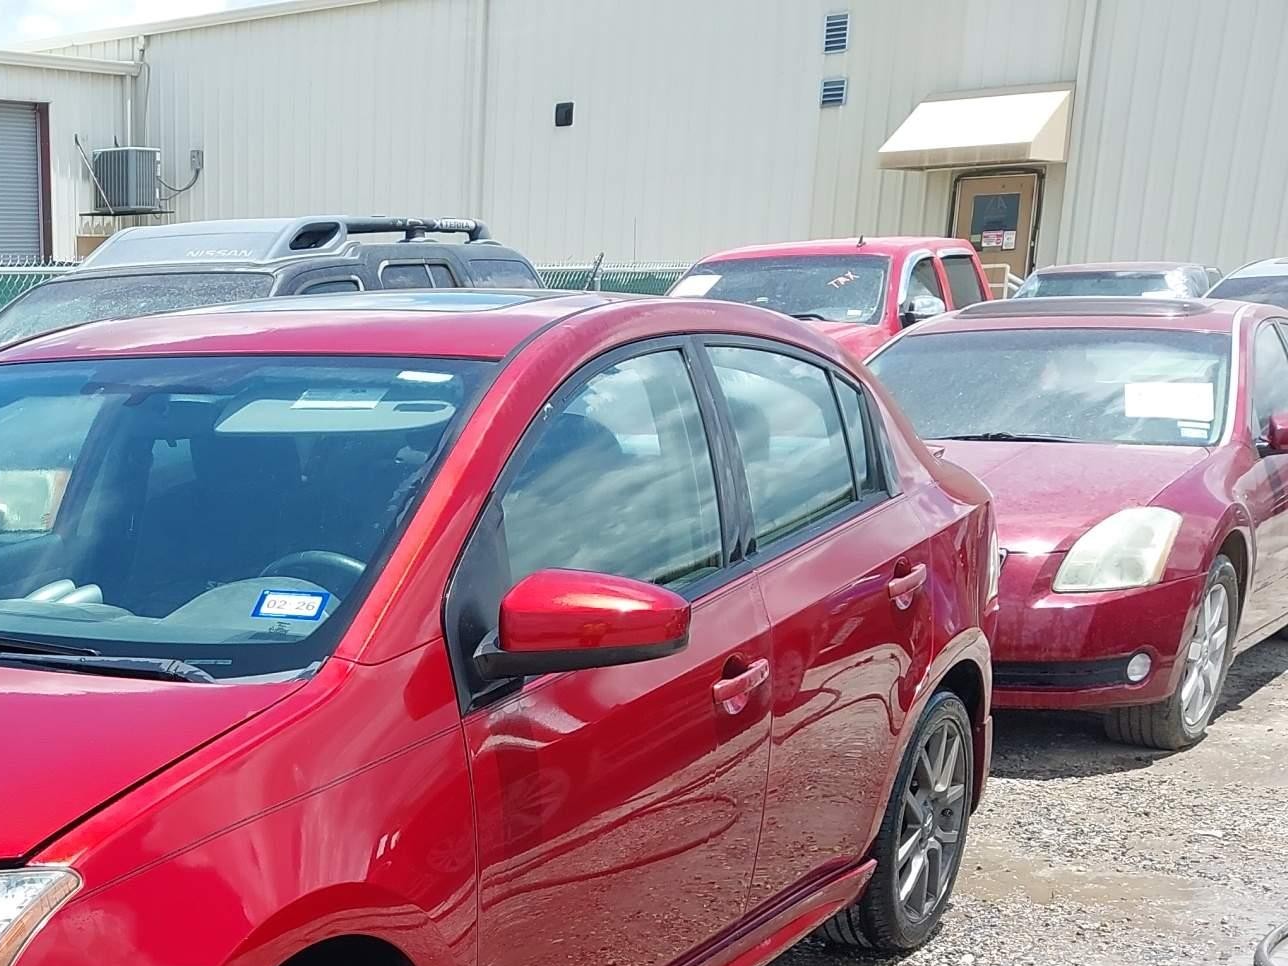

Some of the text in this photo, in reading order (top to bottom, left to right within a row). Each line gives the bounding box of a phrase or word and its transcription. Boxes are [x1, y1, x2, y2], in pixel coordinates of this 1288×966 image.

[185, 247, 253, 257] NISSAN
[266, 599, 315, 611] 02 26
